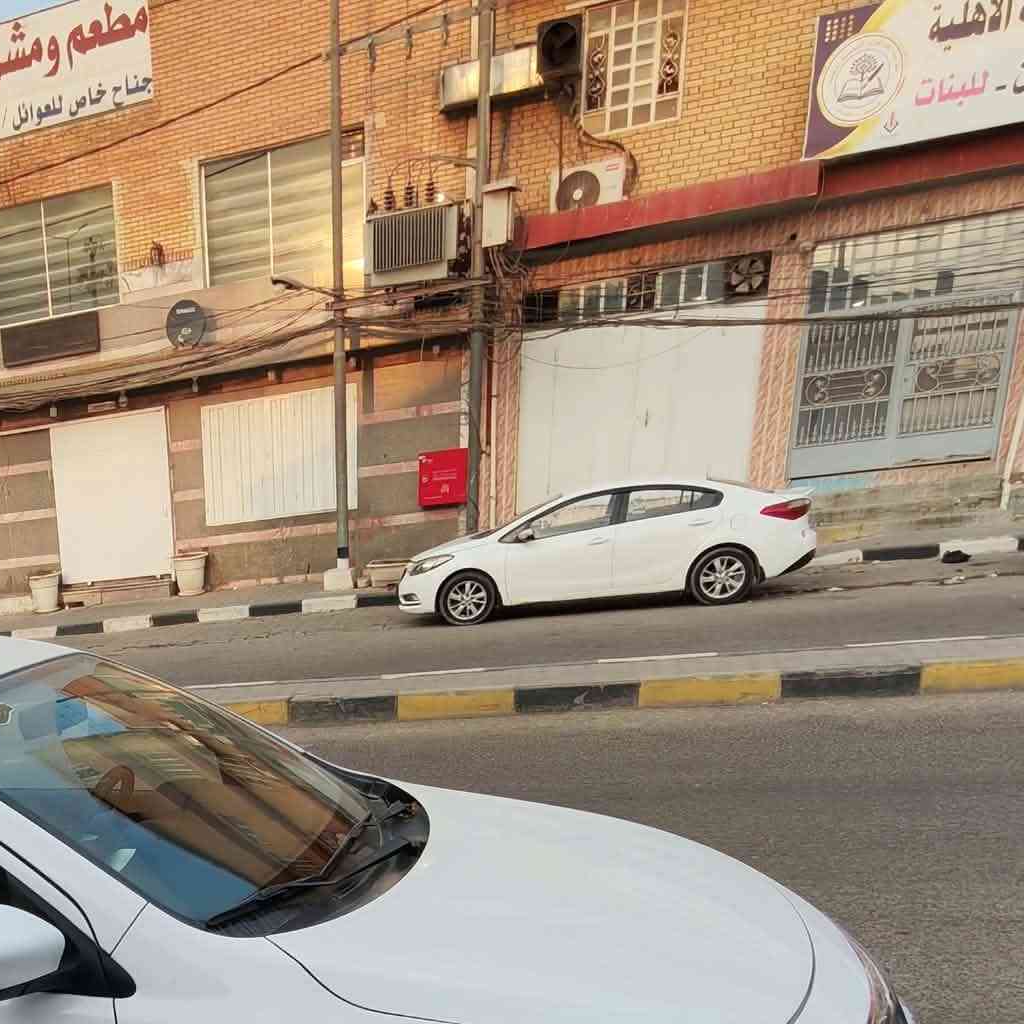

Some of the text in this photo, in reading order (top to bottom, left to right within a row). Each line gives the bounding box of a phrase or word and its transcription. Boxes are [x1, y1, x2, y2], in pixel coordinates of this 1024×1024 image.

[66, 2, 149, 71] مطعم
[68, 79, 107, 116] خاص
[111, 71, 154, 108] جناح
[912, 69, 990, 107] للبنات
[11, 94, 64, 131] للعوائل
